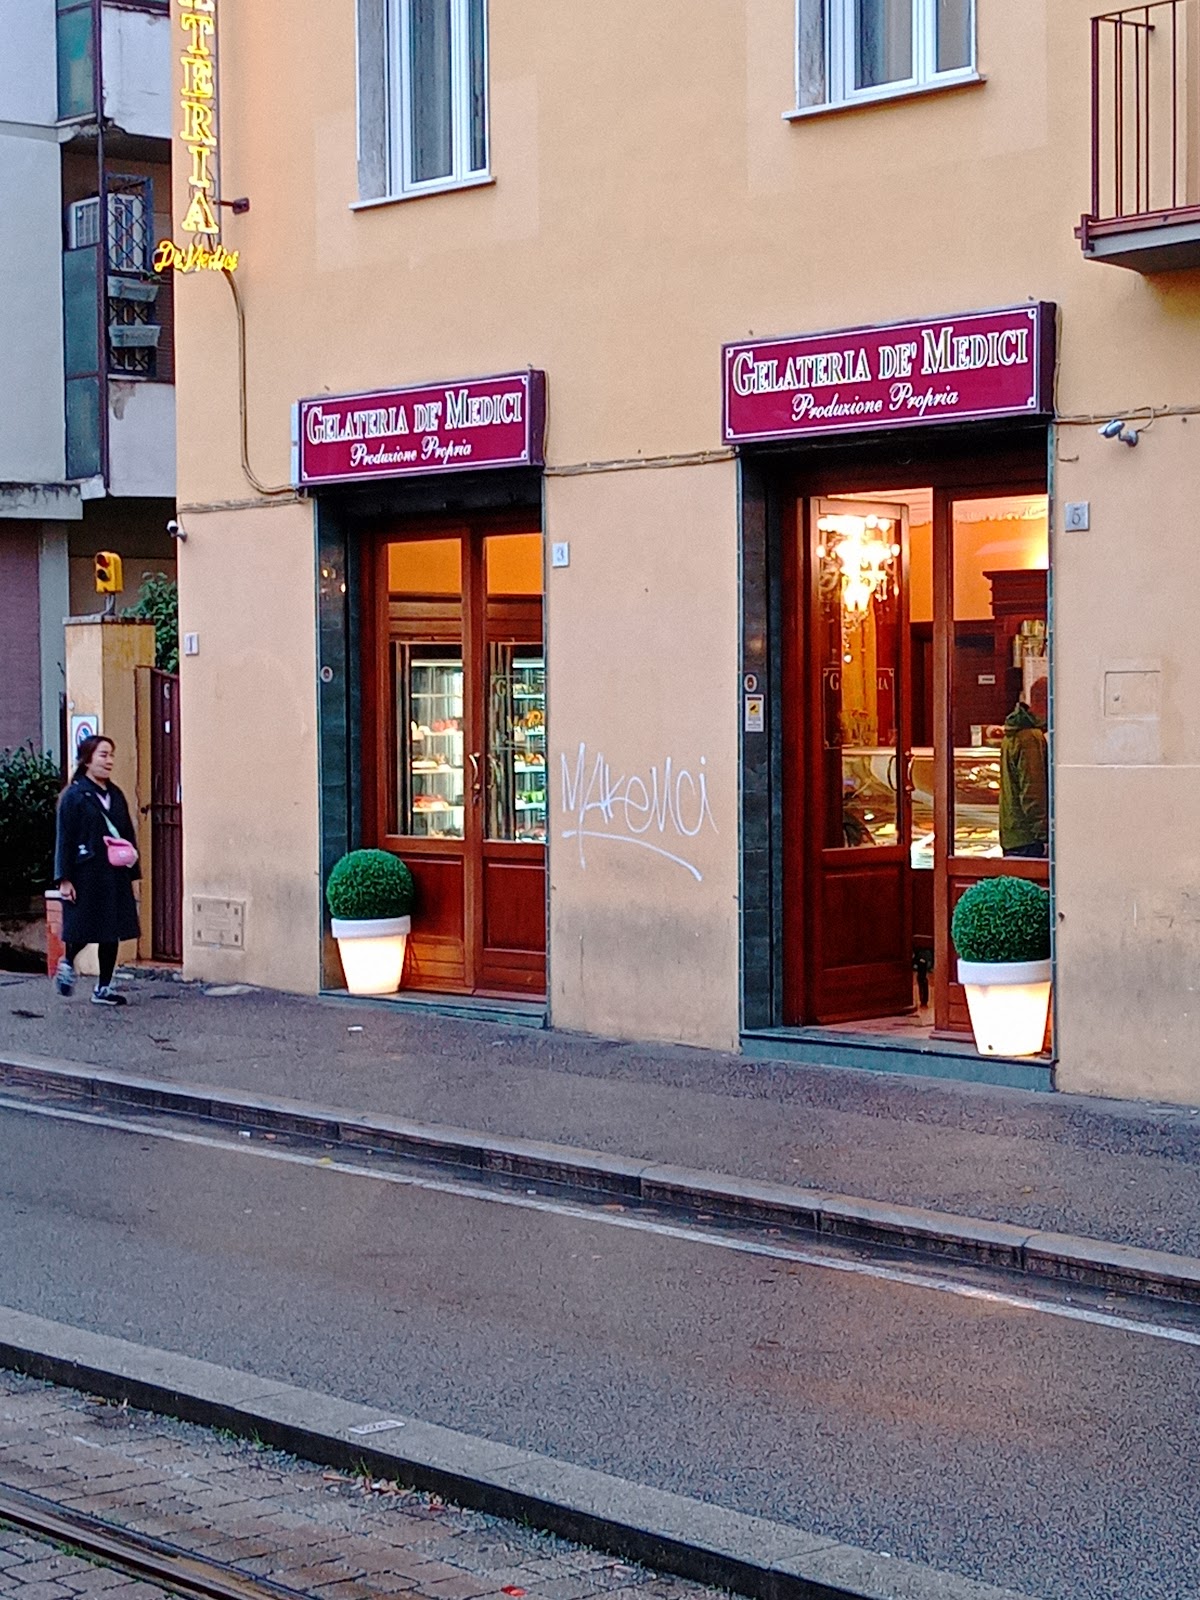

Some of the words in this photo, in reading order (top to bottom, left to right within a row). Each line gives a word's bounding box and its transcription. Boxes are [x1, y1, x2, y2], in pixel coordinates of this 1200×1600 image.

[179, 0, 219, 234] TERIA
[732, 348, 872, 396] GELATERIA
[921, 326, 1028, 375] MEDICI
[306, 405, 409, 445] GELATERIA
[445, 388, 522, 430] MEDICI
[791, 393, 882, 421] Produzione
[889, 382, 958, 416] Propria
[350, 443, 417, 467] Produzione
[421, 435, 471, 465] Propria
[1071, 507, 1081, 526] 5
